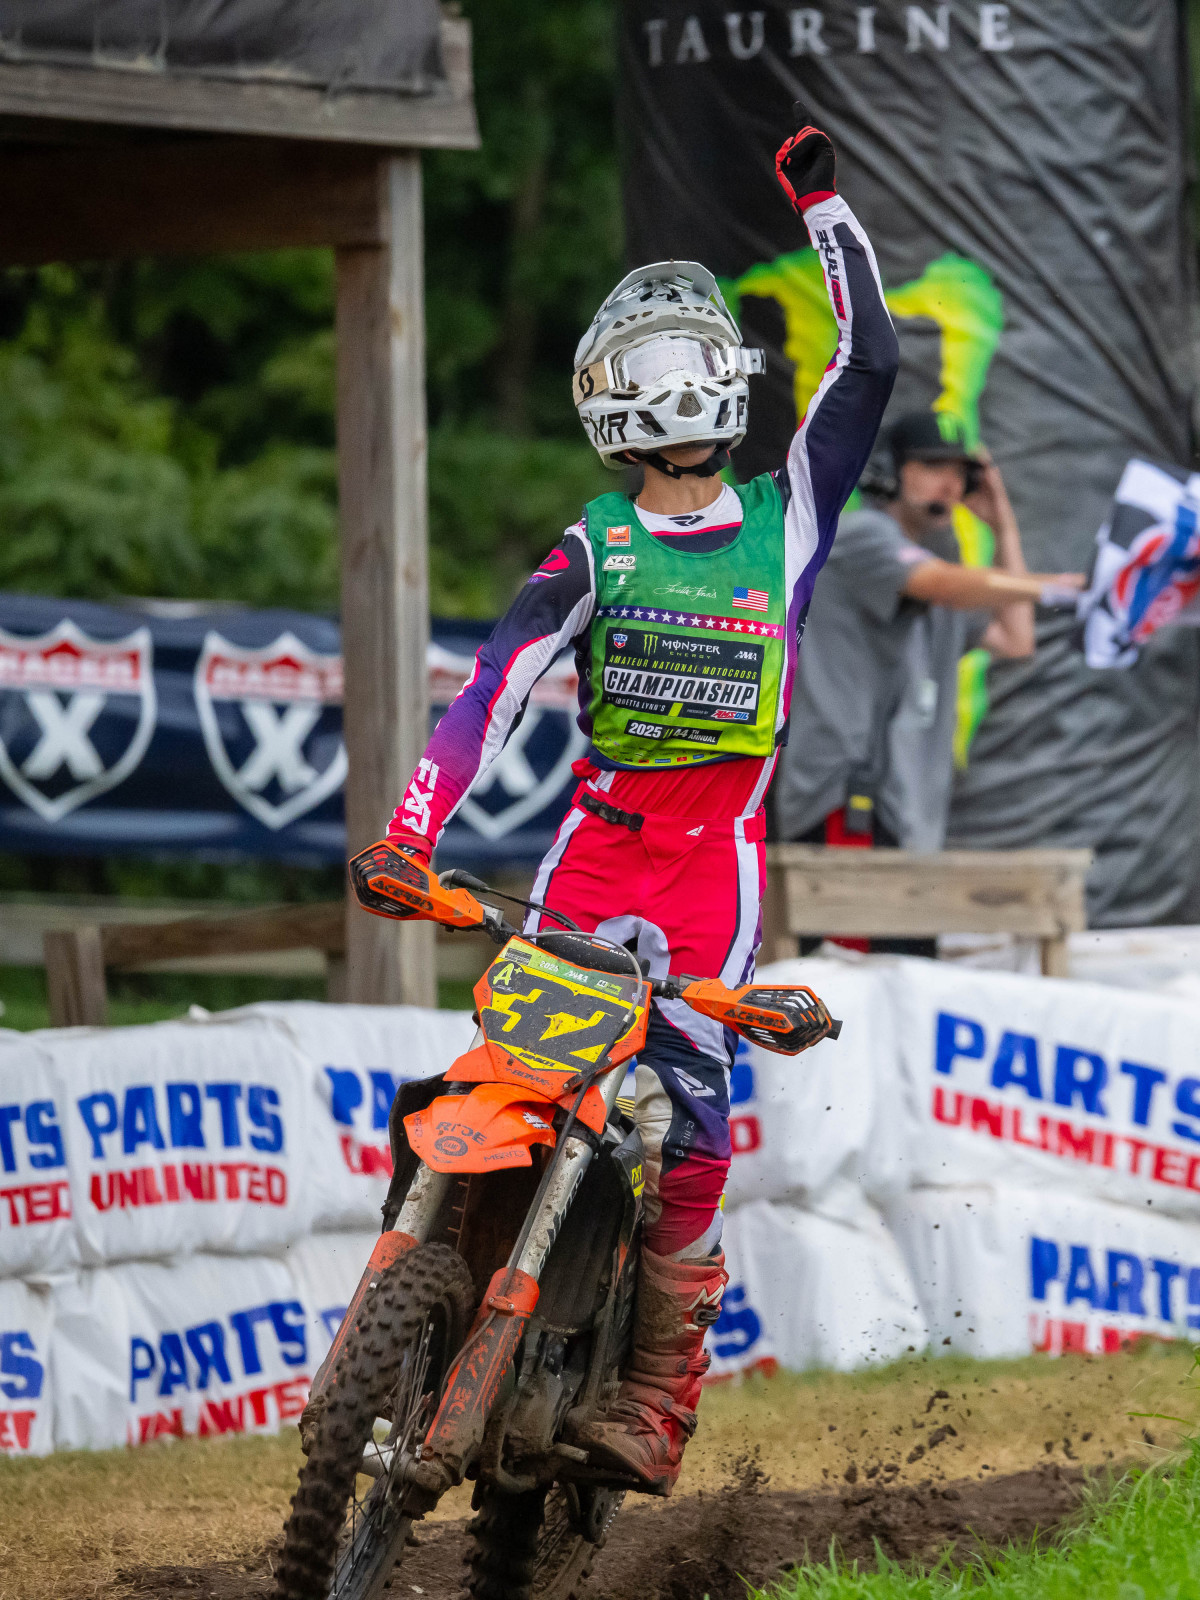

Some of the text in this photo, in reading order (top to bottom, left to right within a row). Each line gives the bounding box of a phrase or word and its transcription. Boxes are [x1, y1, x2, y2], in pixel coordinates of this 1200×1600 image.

[643, 3, 1016, 67] TAURINE
[582, 410, 629, 446] XR
[662, 639, 721, 655] MONSTER
[669, 651, 711, 660] ENERGY
[734, 650, 758, 661] AMA
[608, 655, 758, 680] AMATEUR NATIONAL MOTOCROSS
[606, 670, 755, 706] CHAMPIONSHIP
[628, 722, 663, 738] 2025
[710, 709, 750, 721] AMSOIL
[23, 690, 104, 781] X
[235, 699, 322, 794] X
[687, 734, 716, 743] ANNUAL
[77, 1082, 284, 1159] PARTS
[130, 1301, 308, 1402] PARTS
